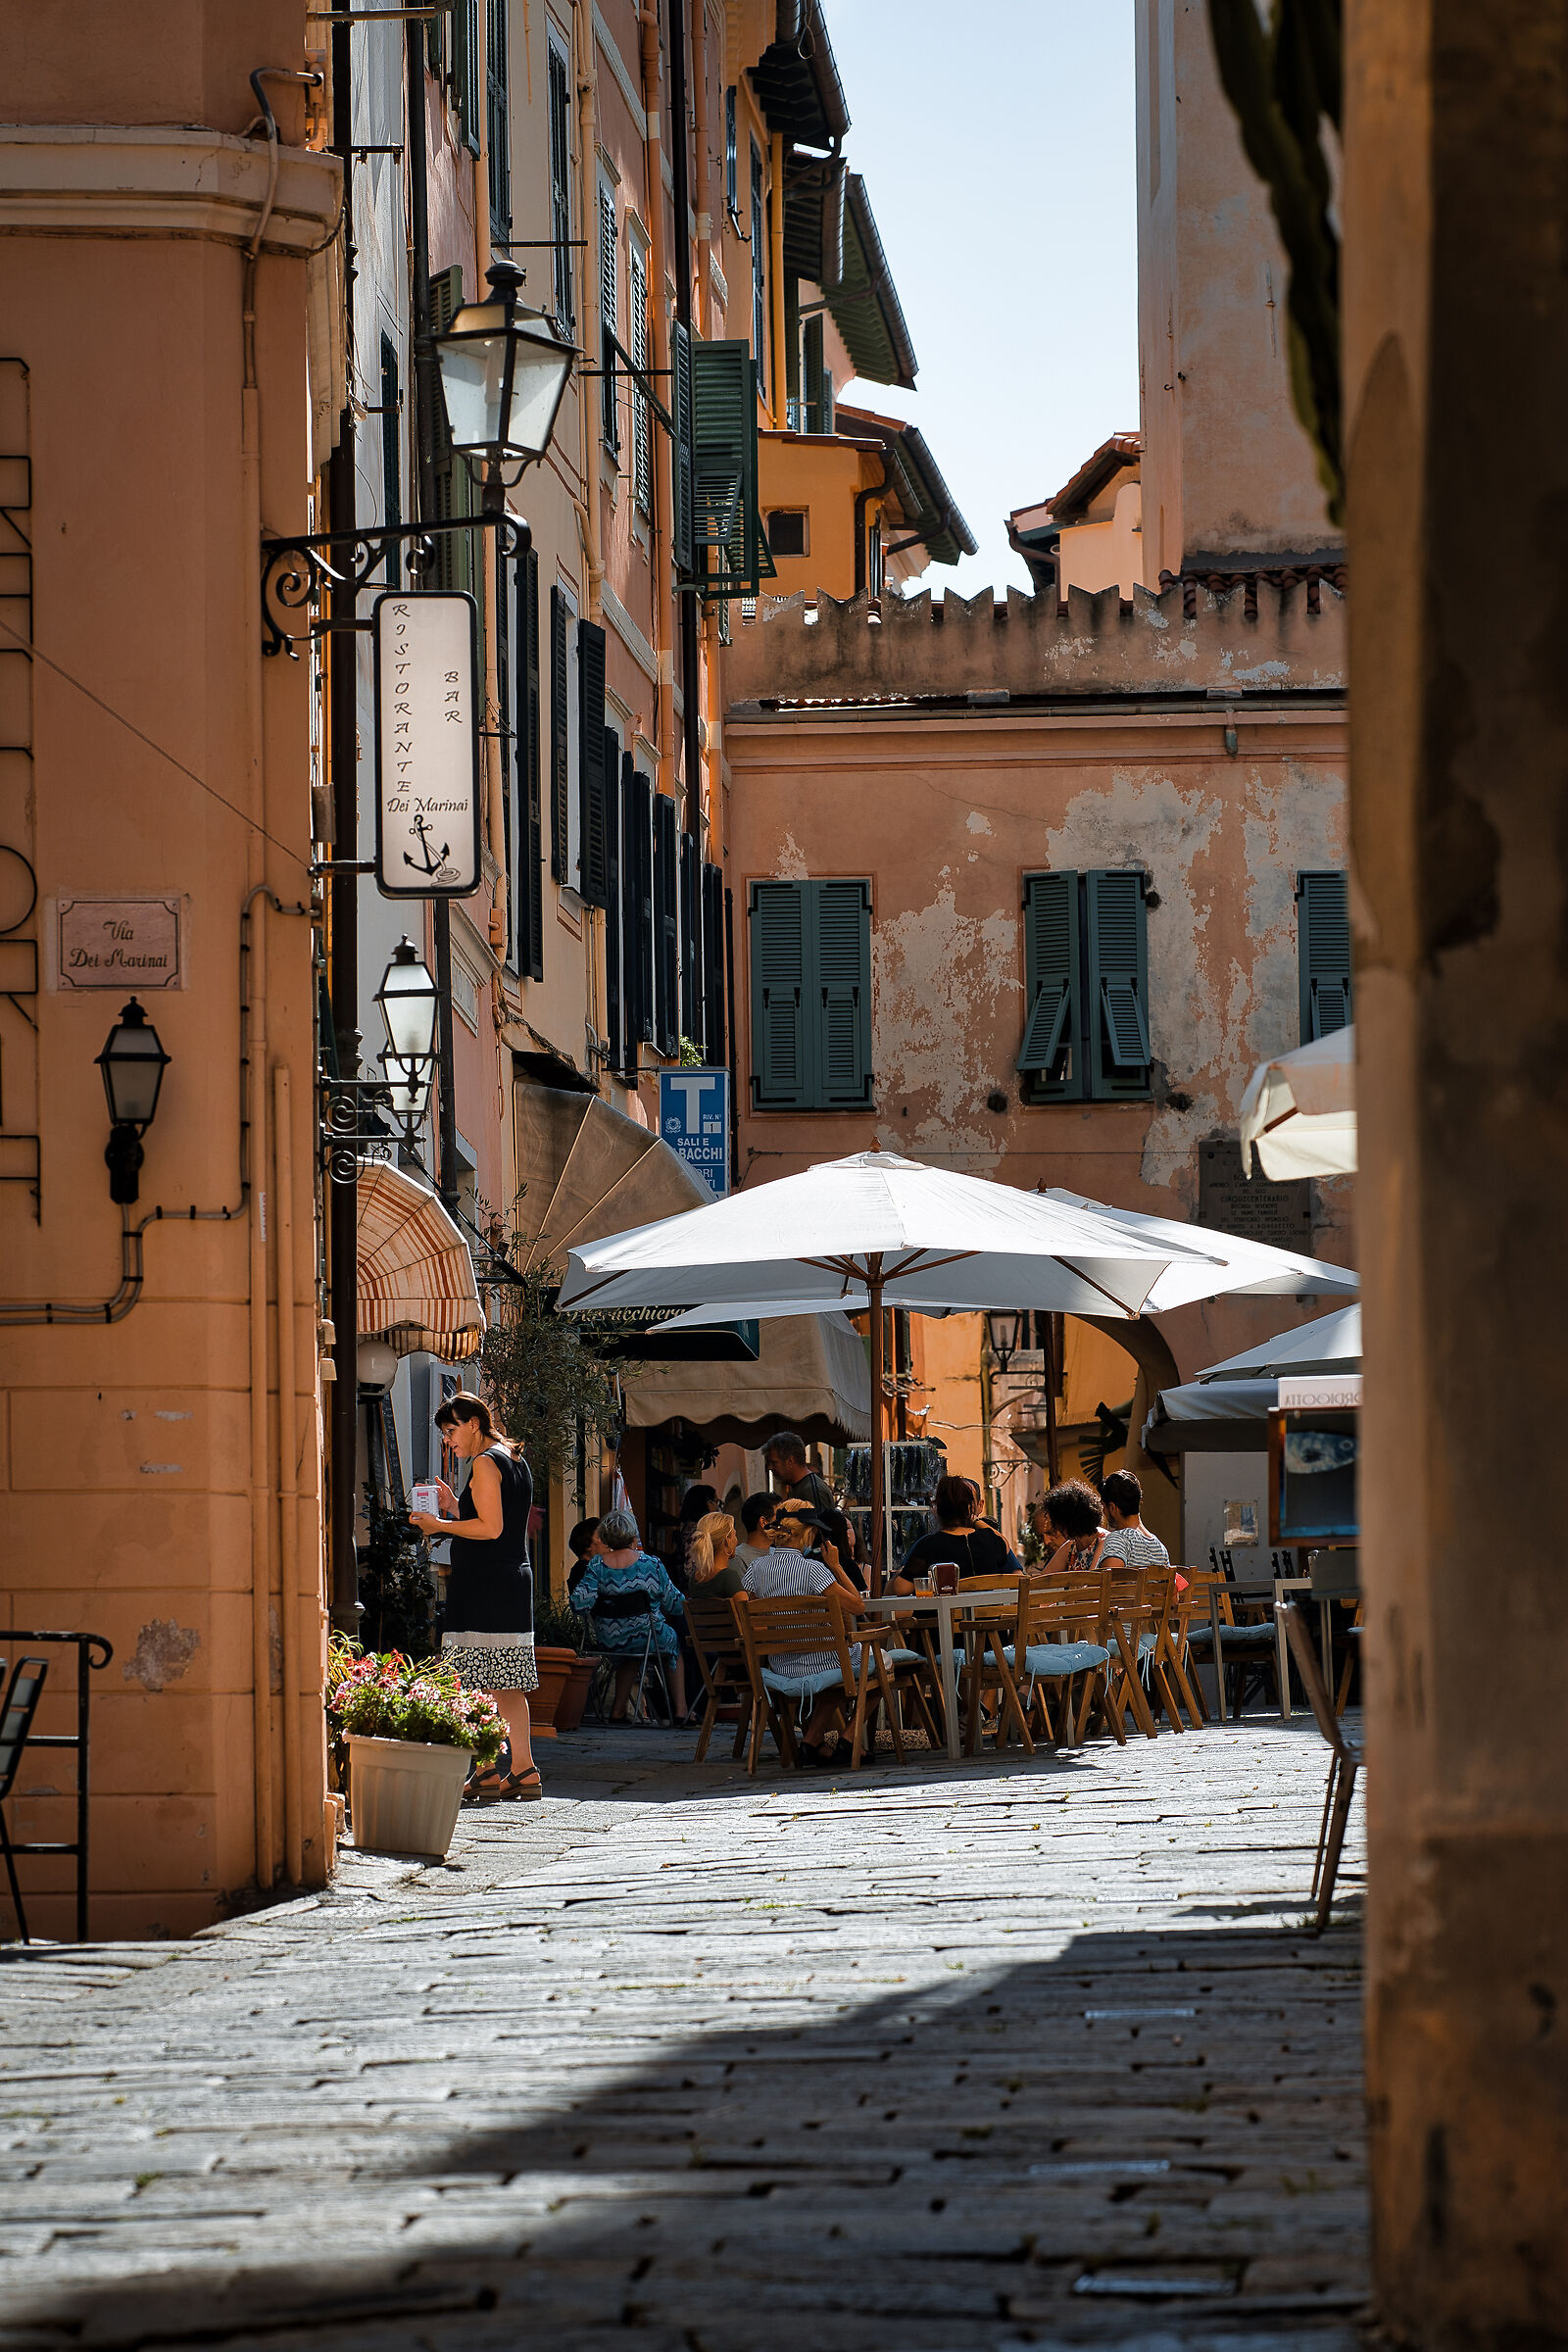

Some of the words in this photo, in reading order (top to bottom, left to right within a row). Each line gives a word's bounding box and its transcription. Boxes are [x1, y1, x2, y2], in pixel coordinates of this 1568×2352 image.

[392, 603, 413, 794] RISTORANTE
[443, 670, 464, 724] BAR
[386, 797, 410, 812] Dei
[414, 797, 468, 812] Marinai
[102, 920, 134, 941] Via
[69, 948, 100, 968] Dei
[104, 948, 168, 968] Marinai
[670, 1076, 715, 1134] T
[710, 1122, 714, 1133] 1
[677, 1137, 700, 1147] SALI
[703, 1137, 710, 1147] E
[678, 1147, 723, 1160] BACCHI
